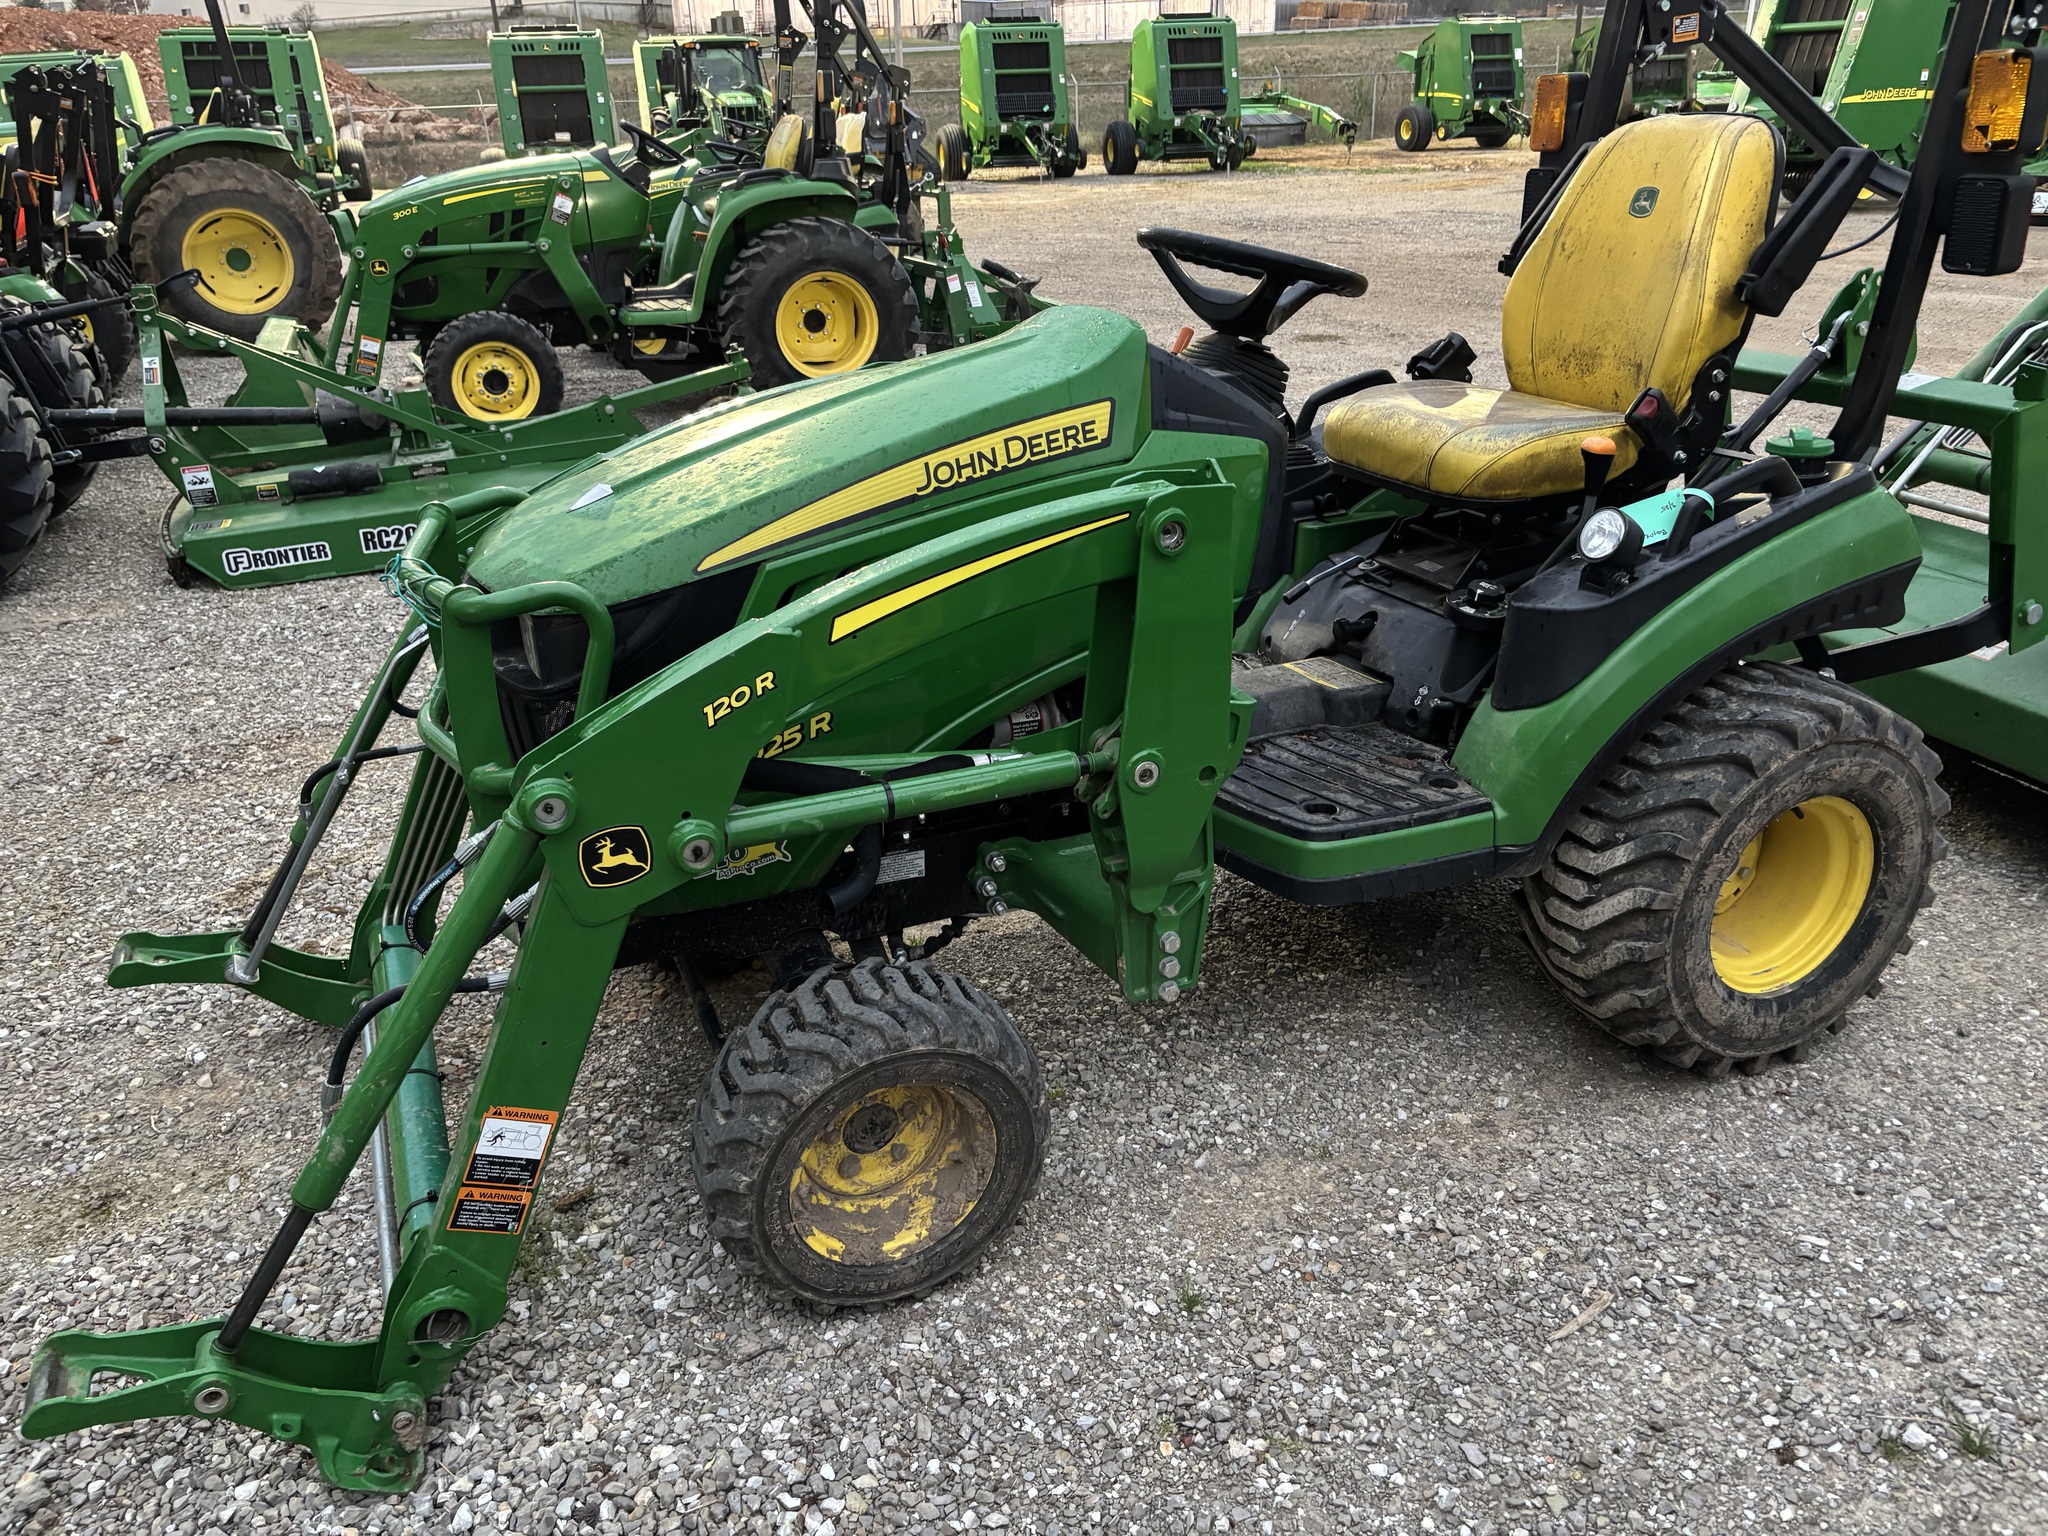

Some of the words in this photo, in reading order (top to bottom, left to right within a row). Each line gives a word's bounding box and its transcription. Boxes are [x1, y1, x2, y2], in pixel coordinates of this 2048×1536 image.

[1860, 88, 1886, 100] JOHN
[1886, 87, 1918, 98] DEERE
[392, 208, 412, 220] 300
[916, 446, 998, 492] JOHN
[1004, 419, 1099, 464] DEERE
[225, 544, 330, 574] FRONTIER
[703, 685, 751, 728] 120
[755, 671, 776, 697] R
[757, 724, 803, 759] 25
[810, 712, 832, 740] R
[720, 854, 775, 878] AgProCo.com
[504, 1110, 549, 1121] WARNING
[479, 1191, 523, 1202] WARNING
